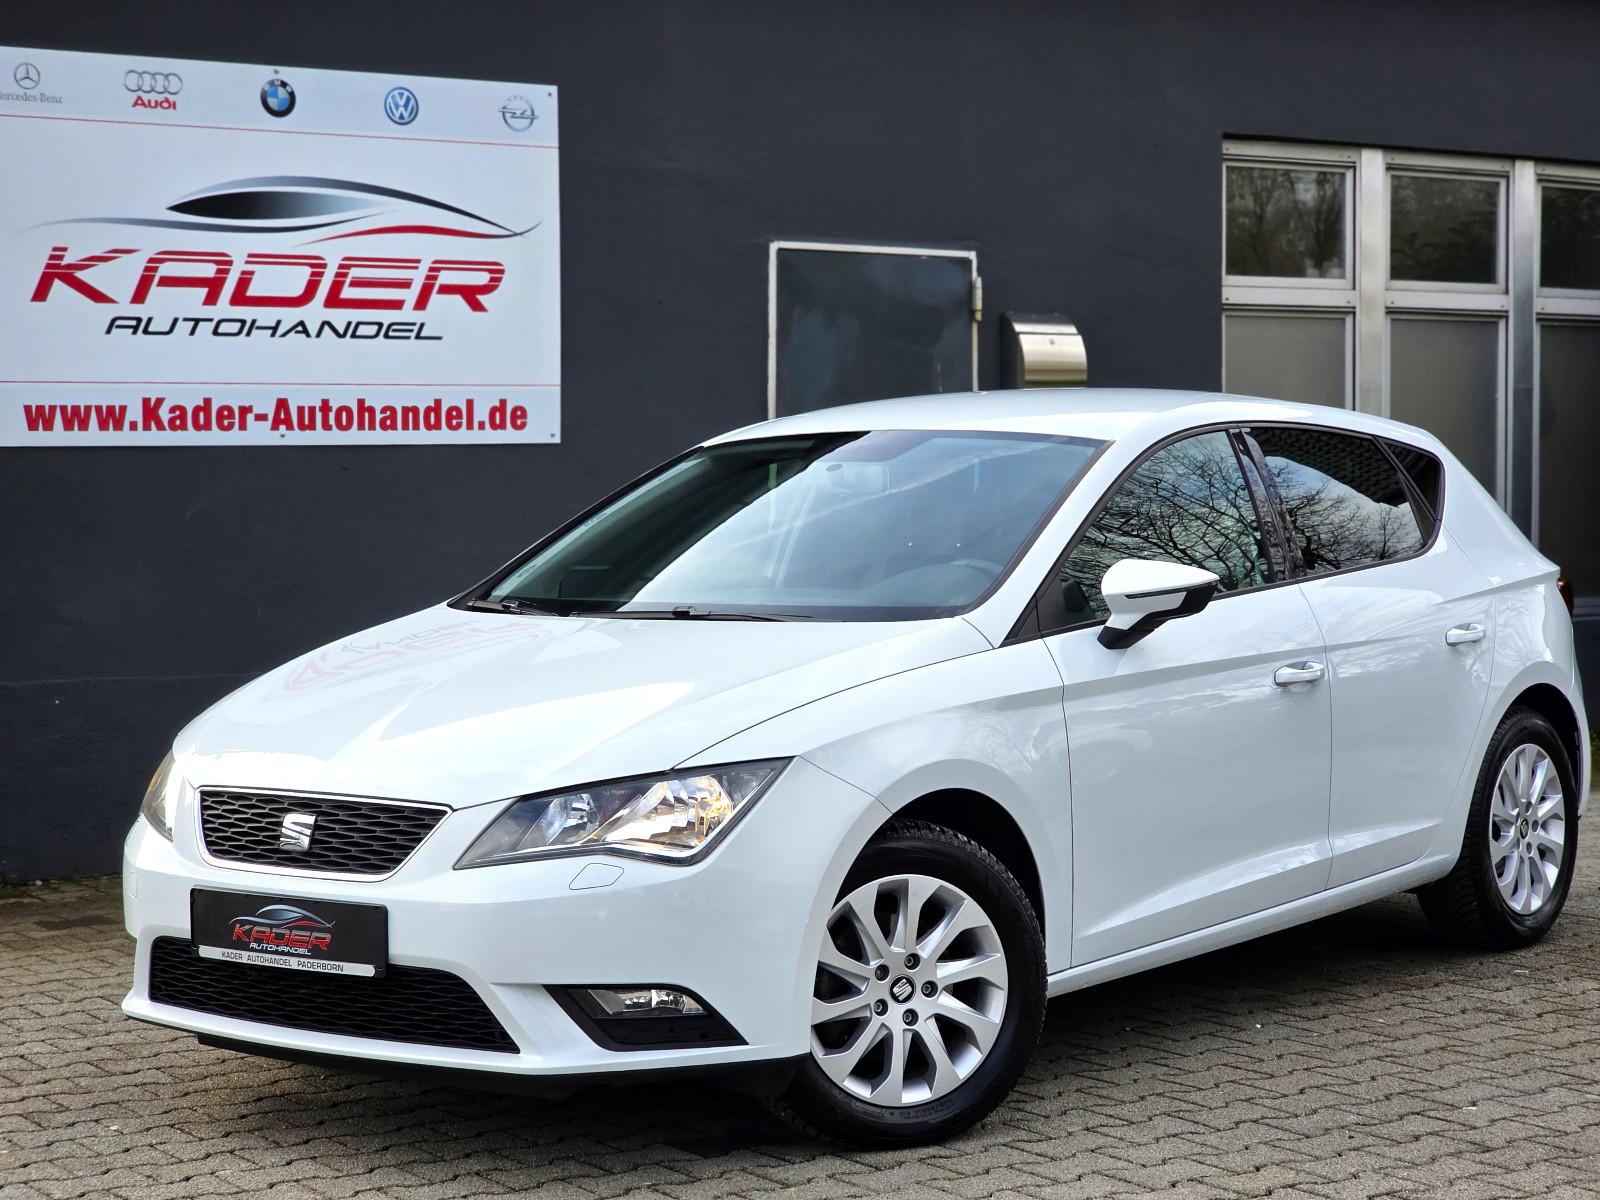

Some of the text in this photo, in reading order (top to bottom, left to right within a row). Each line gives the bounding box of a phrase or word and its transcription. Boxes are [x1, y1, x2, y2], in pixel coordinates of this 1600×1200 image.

[0, 91, 64, 104] ercedes-Benz
[131, 95, 177, 110] Audi
[31, 246, 506, 313] KADER
[105, 315, 443, 341] AUTOHANDEL
[23, 396, 528, 433] www.Kader-Autohandel.de
[232, 923, 332, 950] KADER
[249, 942, 312, 956] AUTOHANDEL
[221, 951, 344, 973] KADER AUTOHANDEL PADERBORN
